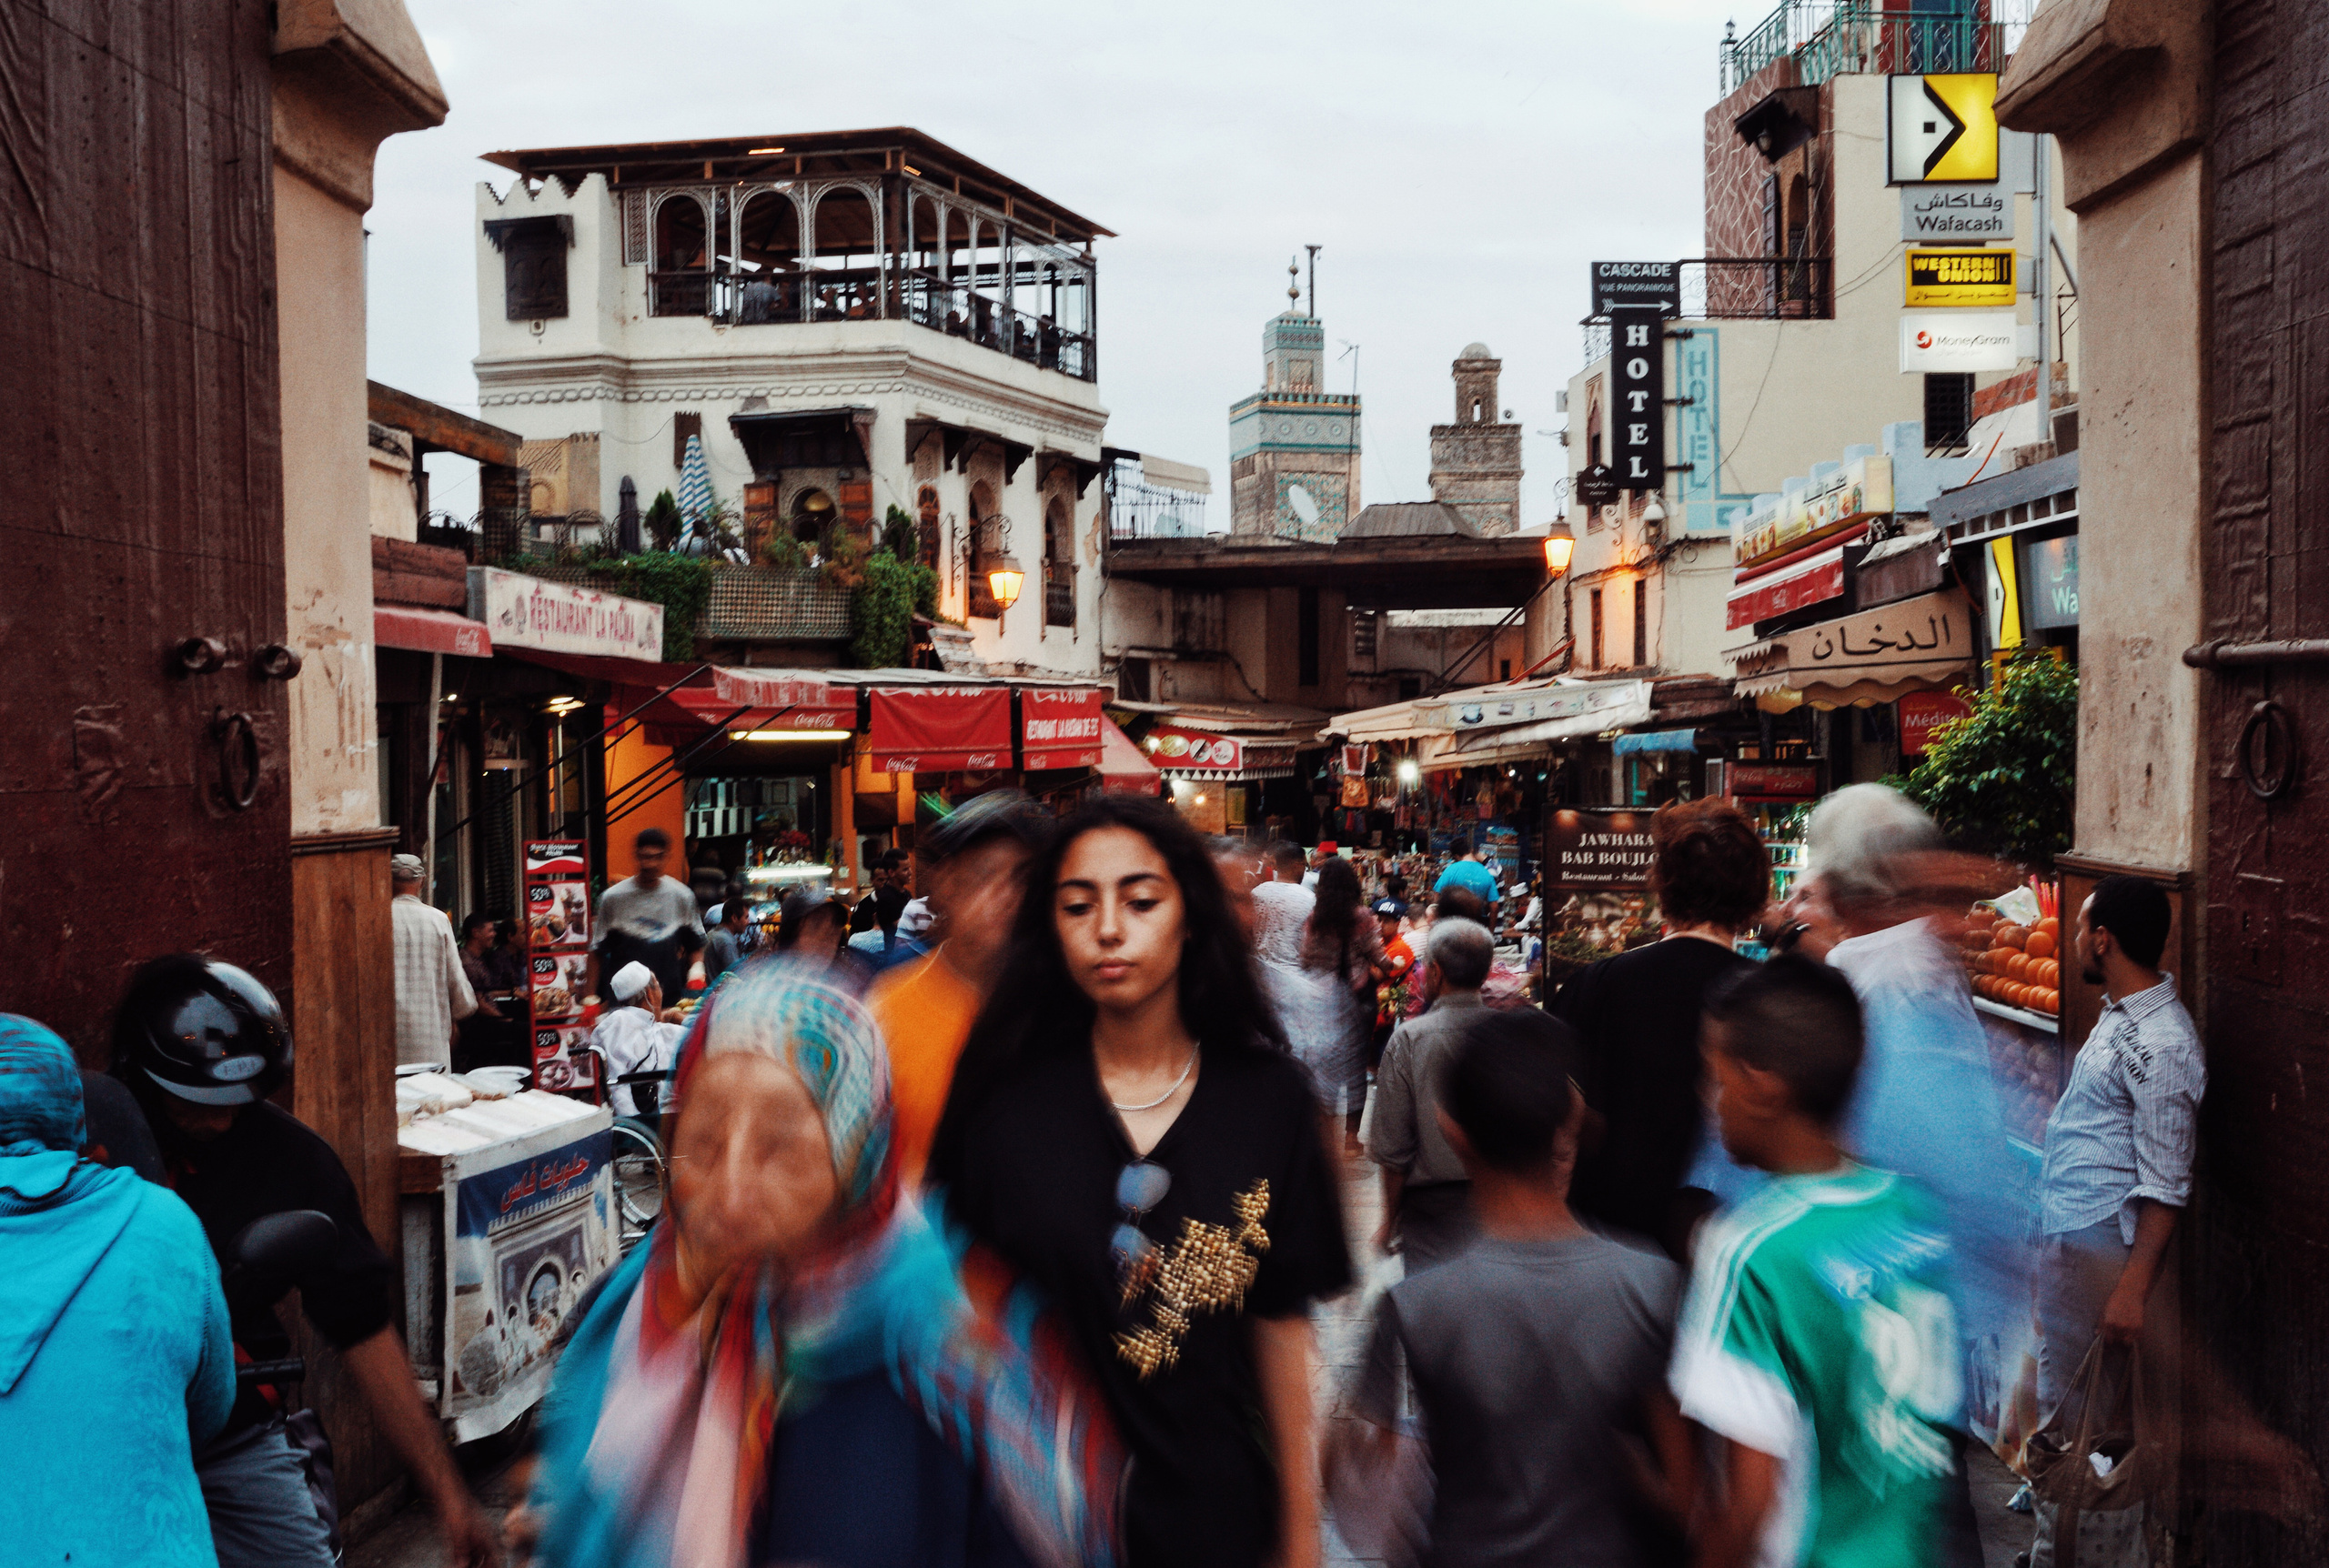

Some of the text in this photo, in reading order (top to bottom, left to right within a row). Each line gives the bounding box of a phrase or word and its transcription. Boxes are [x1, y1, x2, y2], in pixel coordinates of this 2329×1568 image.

[1914, 192, 2002, 211] وفاكاش
[1915, 215, 2002, 231] Wafacash
[1599, 264, 1671, 276] CASCADE
[1912, 257, 1995, 270] WESTERN
[1937, 269, 1995, 282] UNION
[1598, 283, 1675, 292] VUE PANORAMIQUE
[1936, 335, 2011, 347] MoneyGram
[1625, 324, 1649, 478] HOTEL
[1688, 351, 1708, 489] HOTEL
[530, 596, 592, 637] RESTAURANT
[1812, 613, 1950, 660] الدخان
[1904, 709, 1964, 728] Méditl
[1578, 833, 1654, 847] JAWHARA
[1561, 851, 1594, 864] BAB
[1561, 871, 1612, 880] Restaurant
[500, 1151, 590, 1213] حلويات فاس
